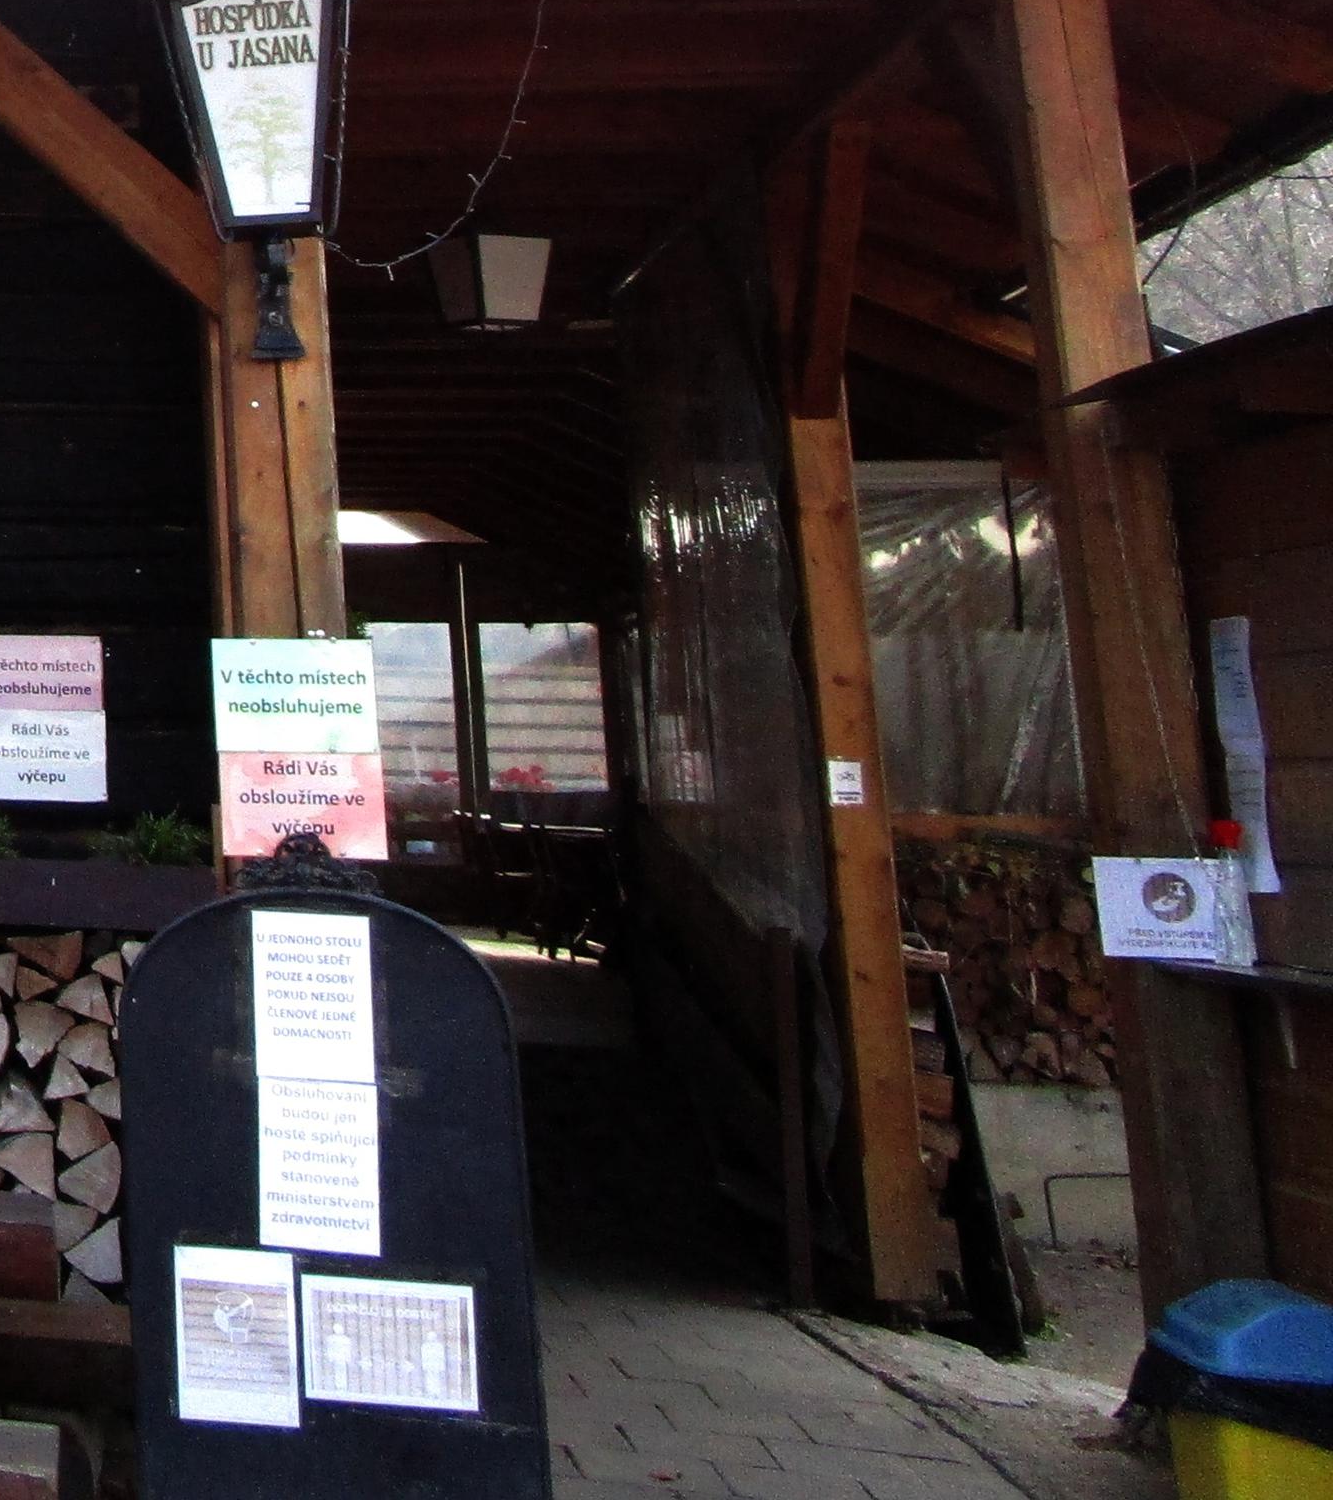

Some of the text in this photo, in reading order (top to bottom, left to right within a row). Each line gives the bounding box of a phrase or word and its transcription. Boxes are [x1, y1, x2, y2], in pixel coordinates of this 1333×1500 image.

[192, 0, 312, 36] HOSPŮDKA
[196, 34, 317, 70] U JASANA
[42, 660, 96, 673] místech
[220, 669, 367, 686] V těchto místech
[228, 698, 363, 717] neobsluhujeme
[11, 723, 70, 737] Rádi Vás
[74, 750, 91, 760] ve
[18, 769, 67, 785] výčepu
[263, 760, 338, 777] Rádi Vás
[239, 789, 366, 806] obsloužíme ve
[256, 933, 362, 948] U JEDNOHO STOLU
[267, 952, 352, 966] MOHOU SEDĚT
[266, 970, 355, 985] POUZE 4 OSOBY
[267, 989, 355, 1003] POKUD NEJSOU
[267, 1005, 357, 1023] ČLENOVÉ JEDNÉ
[282, 1107, 357, 1126] budou jen
[281, 1169, 360, 1188] stanovené
[266, 1189, 375, 1210] ministerstvem
